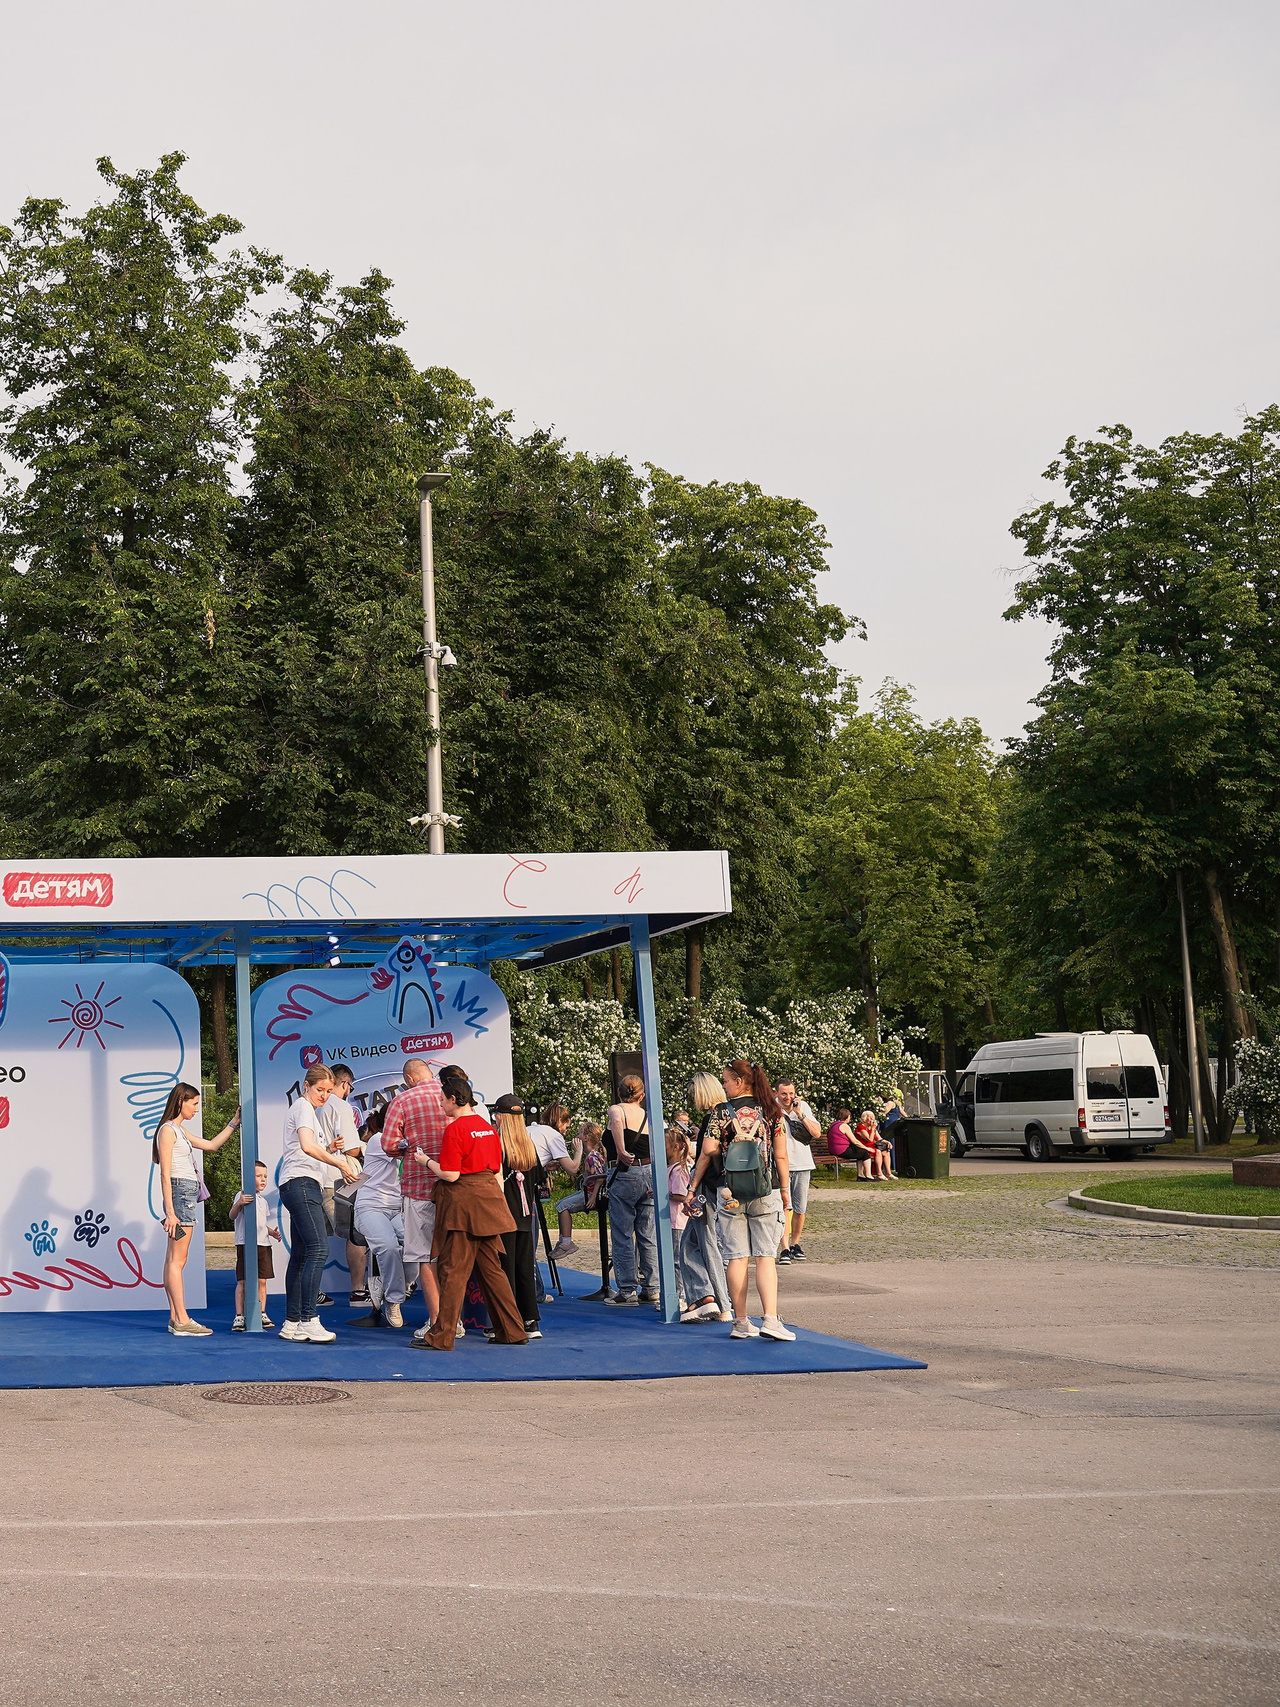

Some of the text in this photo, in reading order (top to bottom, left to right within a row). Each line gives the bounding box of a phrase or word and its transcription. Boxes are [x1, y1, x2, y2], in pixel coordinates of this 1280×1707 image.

[13, 878, 104, 905] детям
[326, 1034, 450, 1061] VK Видео детям
[354, 1082, 409, 1111] ТАТ
